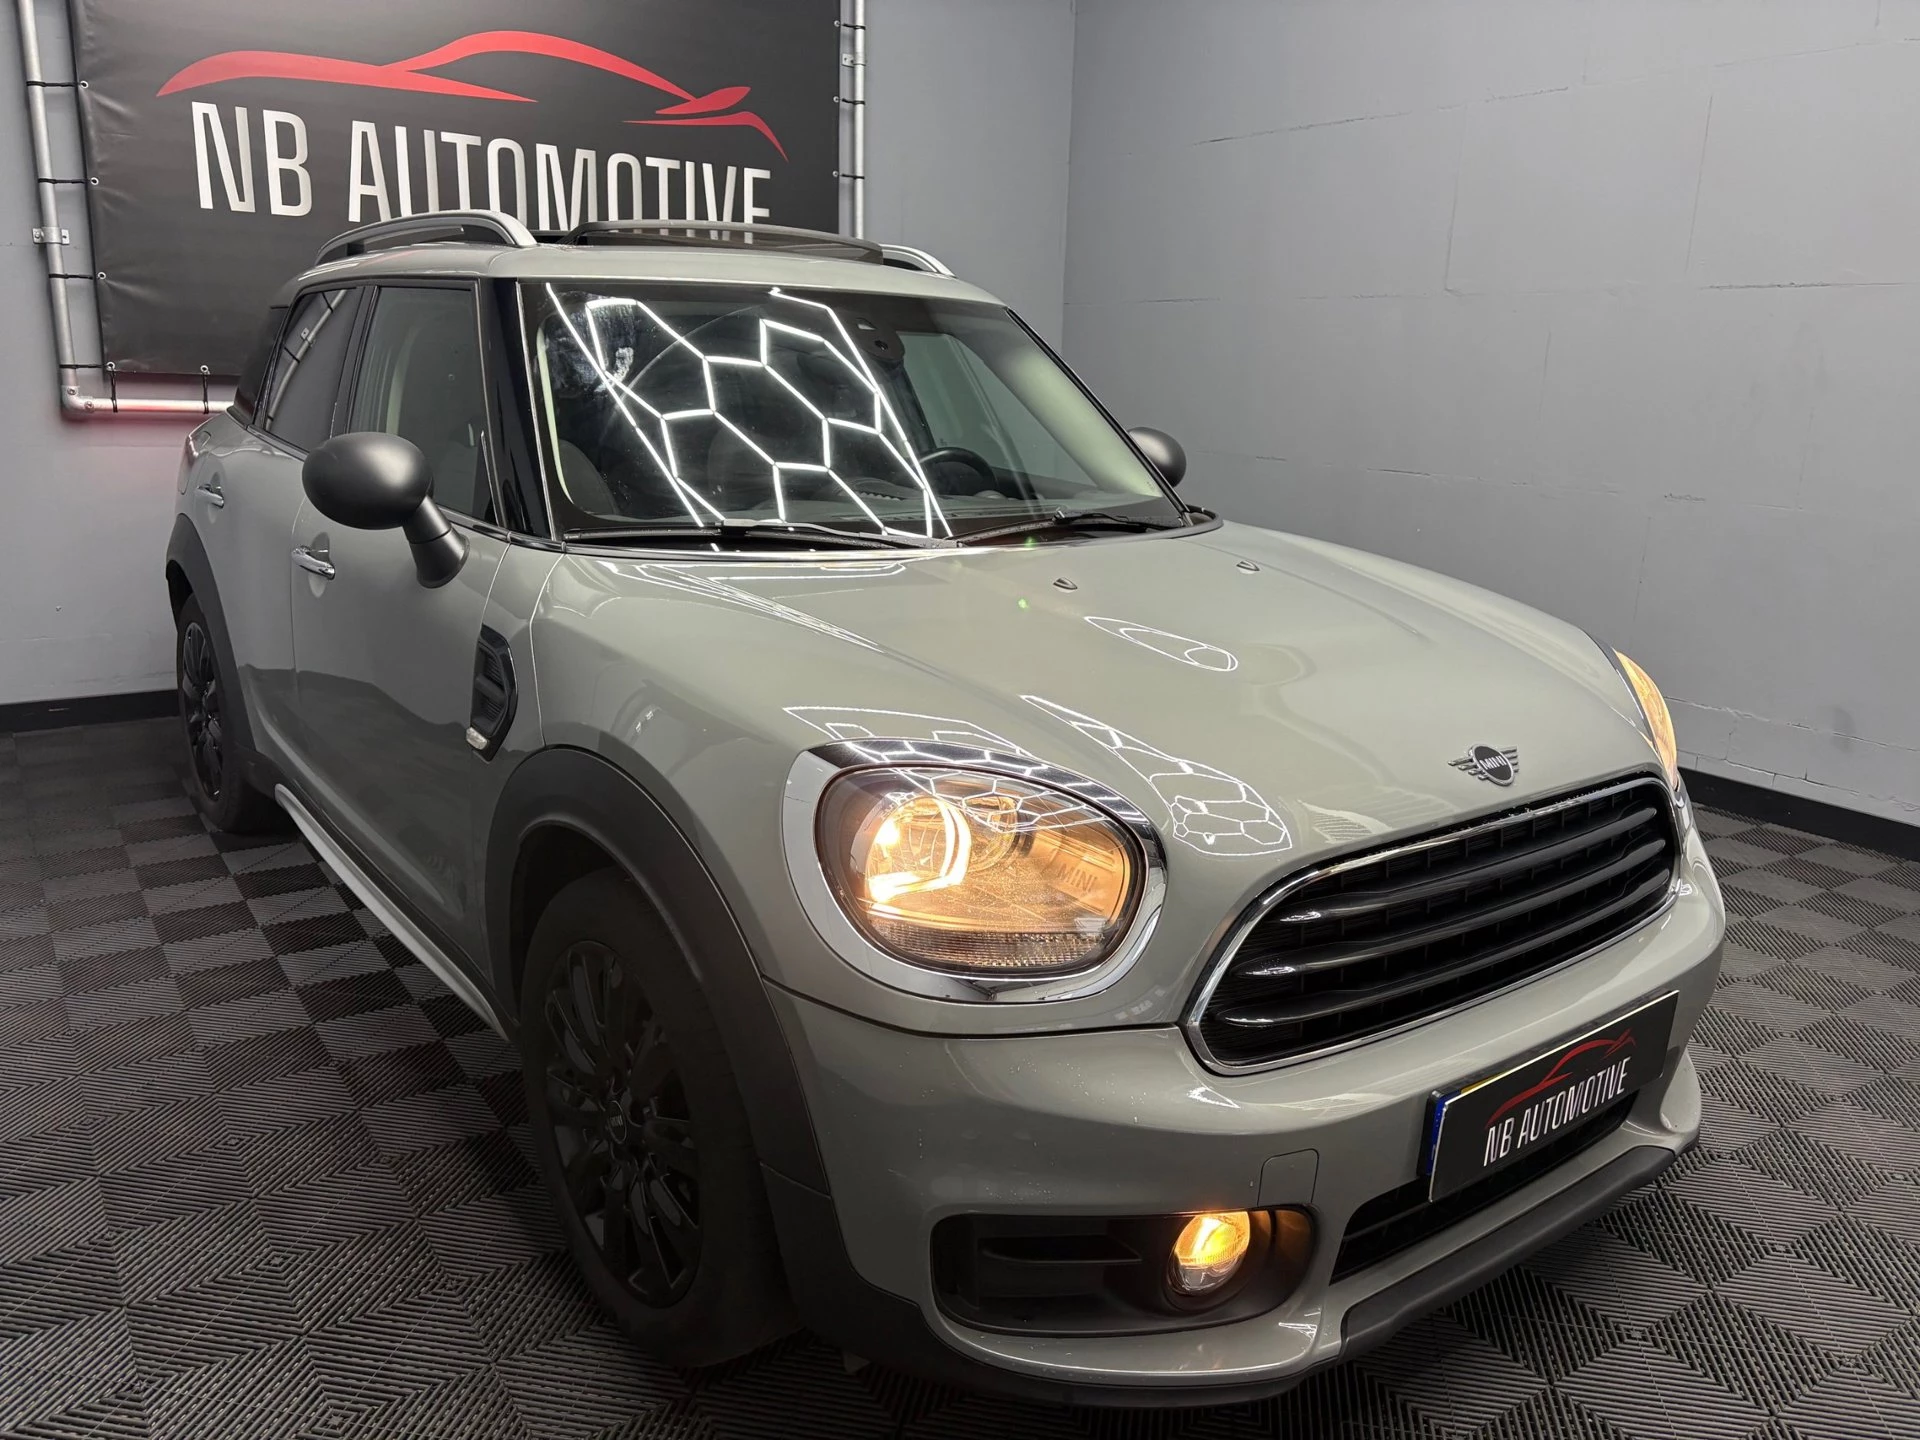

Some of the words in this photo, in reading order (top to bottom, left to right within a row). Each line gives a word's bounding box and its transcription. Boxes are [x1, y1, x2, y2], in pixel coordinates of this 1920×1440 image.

[192, 101, 312, 217] NB
[348, 120, 772, 236] AUTOMOTIVE
[1480, 755, 1507, 770] MINI
[1057, 863, 1098, 892] MINI
[1483, 1117, 1515, 1167] NB
[1517, 1056, 1631, 1149] AUTOMOTIVE
